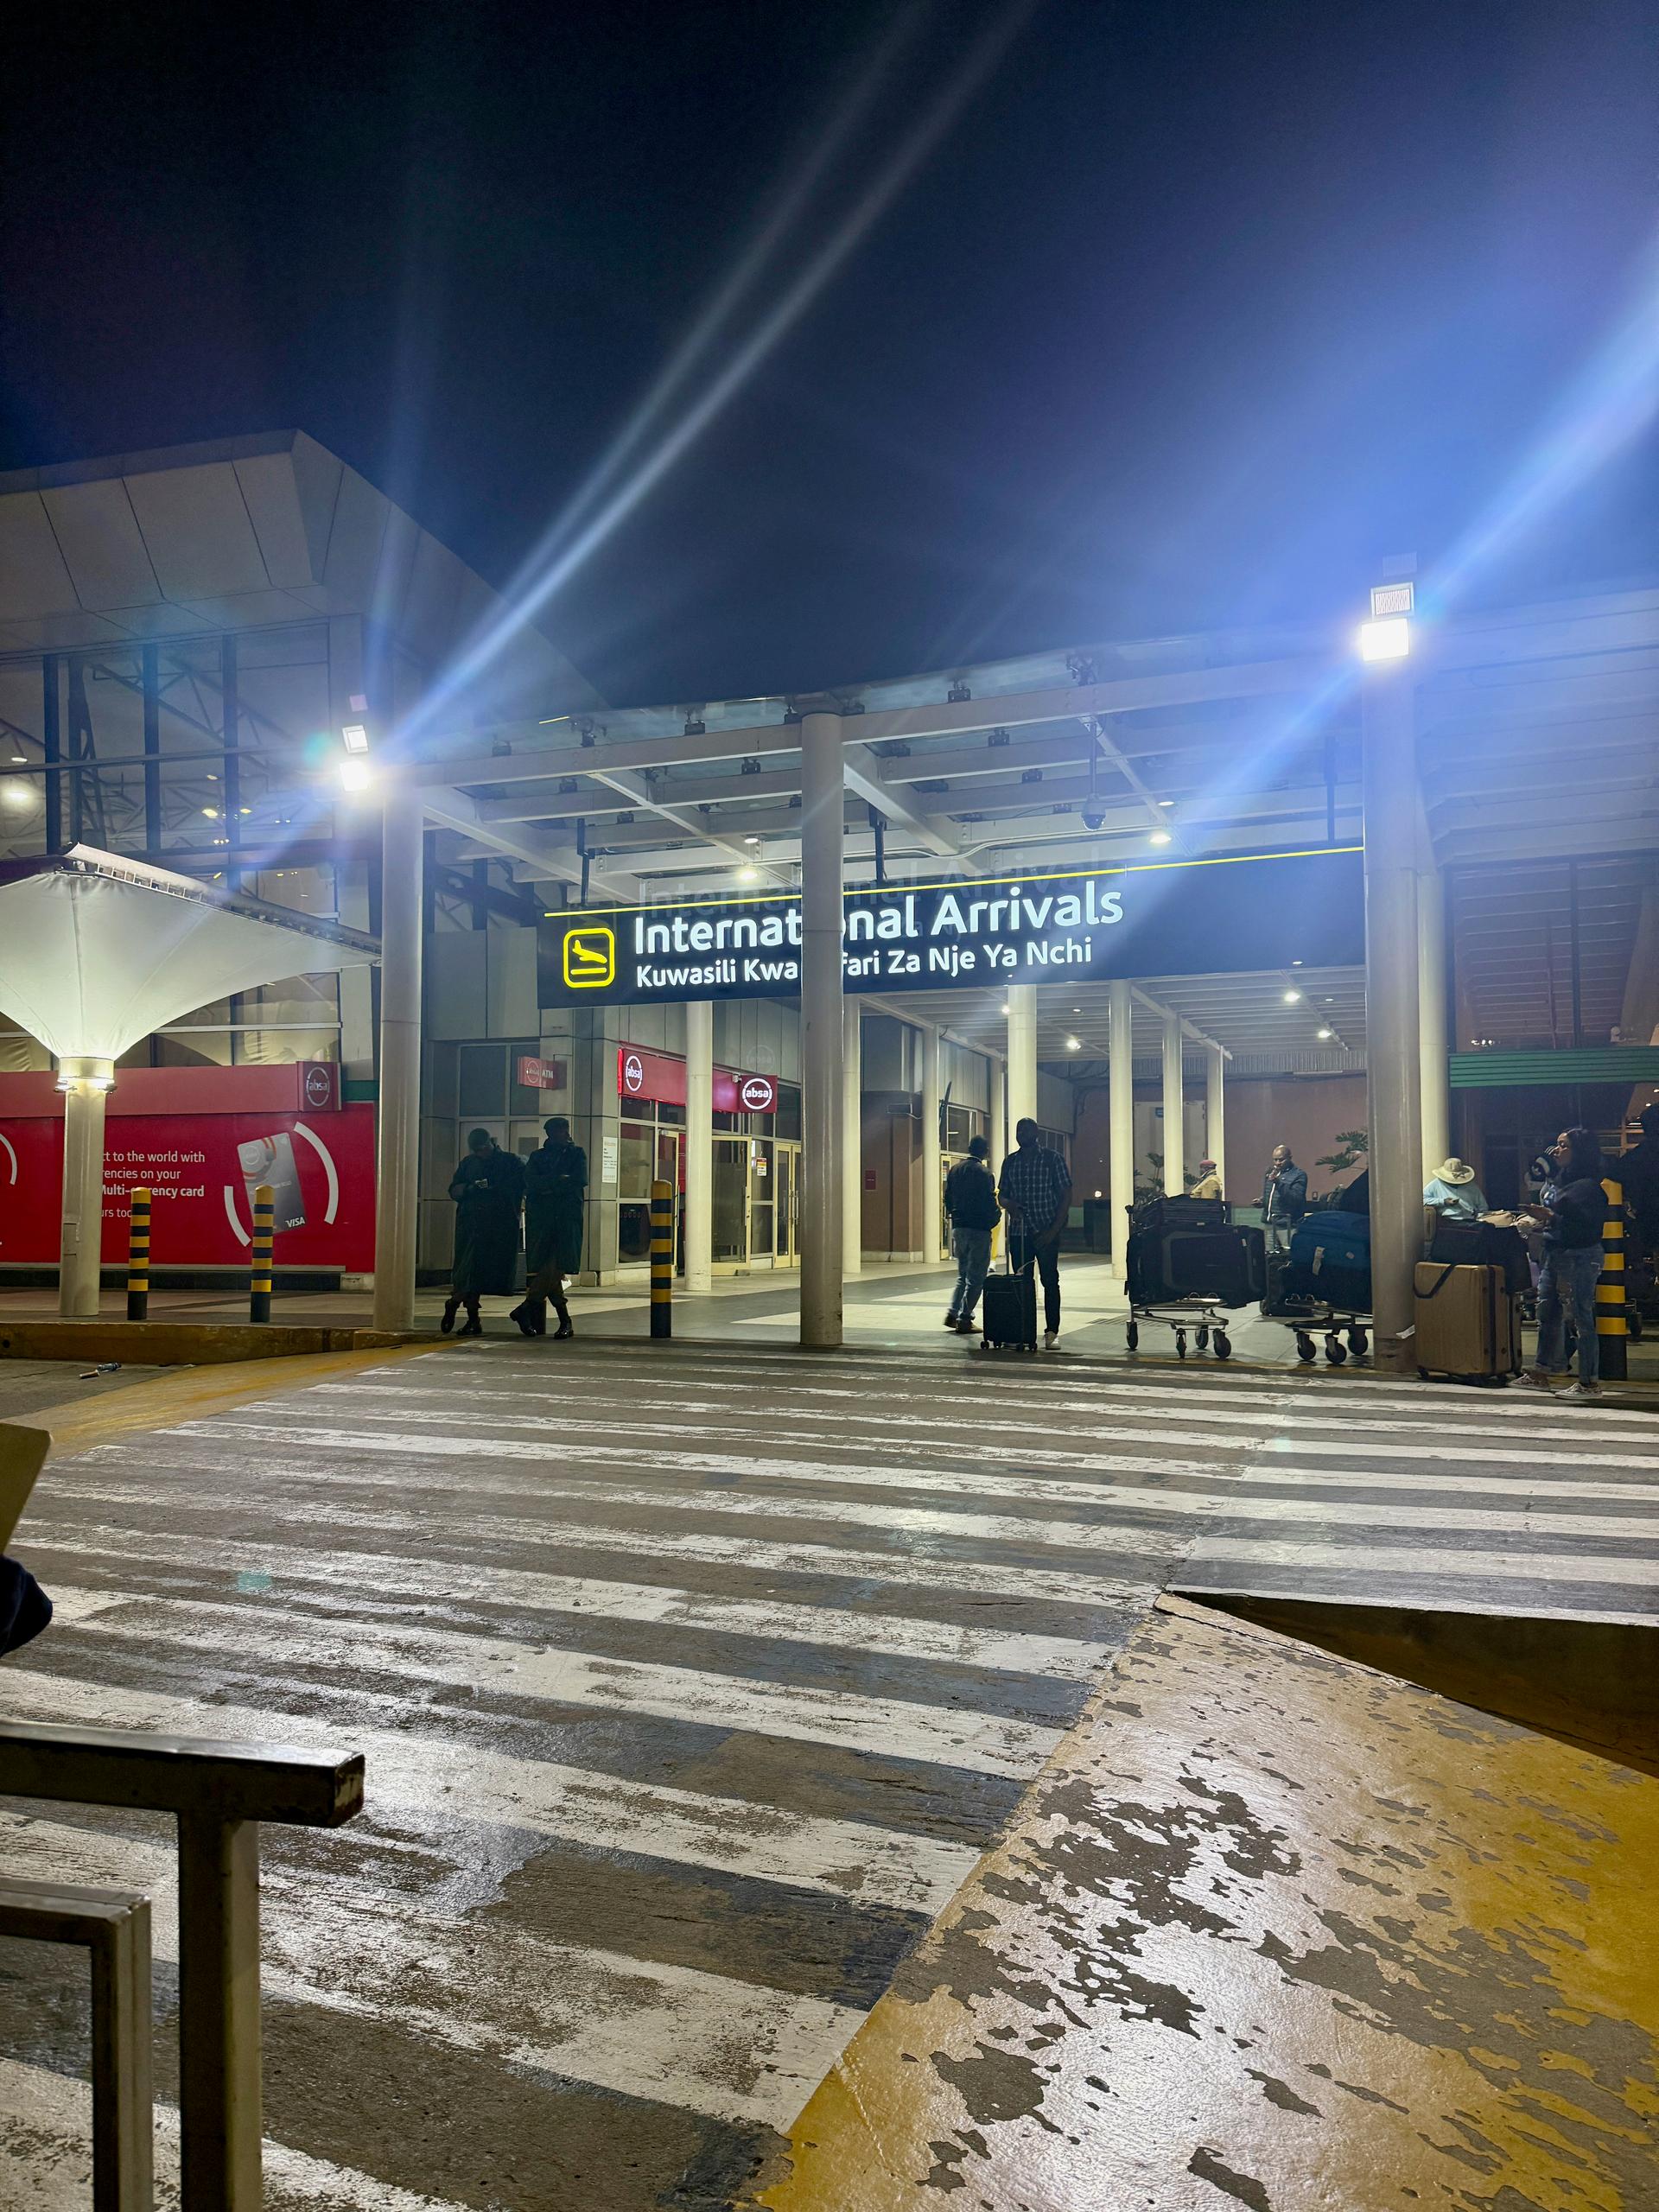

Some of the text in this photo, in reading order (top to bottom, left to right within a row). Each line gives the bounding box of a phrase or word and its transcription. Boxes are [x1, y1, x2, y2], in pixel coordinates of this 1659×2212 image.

[635, 880, 1123, 955] Internatnal Arrivals
[637, 959, 736, 988] Kuwasili
[744, 958, 798, 982] Kwa
[887, 950, 921, 974] Za
[929, 945, 976, 977] Nje
[982, 944, 1018, 968] Ya
[1027, 936, 1092, 966] Nchi
[628, 1065, 641, 1079] absa
[746, 1087, 769, 1098] absa
[112, 1151, 124, 1162] to
[126, 1150, 145, 1162] the
[148, 1150, 178, 1163] world
[181, 1151, 206, 1163] with
[140, 1170, 154, 1179] on
[156, 1170, 181, 1182] your
[180, 1185, 205, 1197] card
[285, 1217, 306, 1228] VISA
